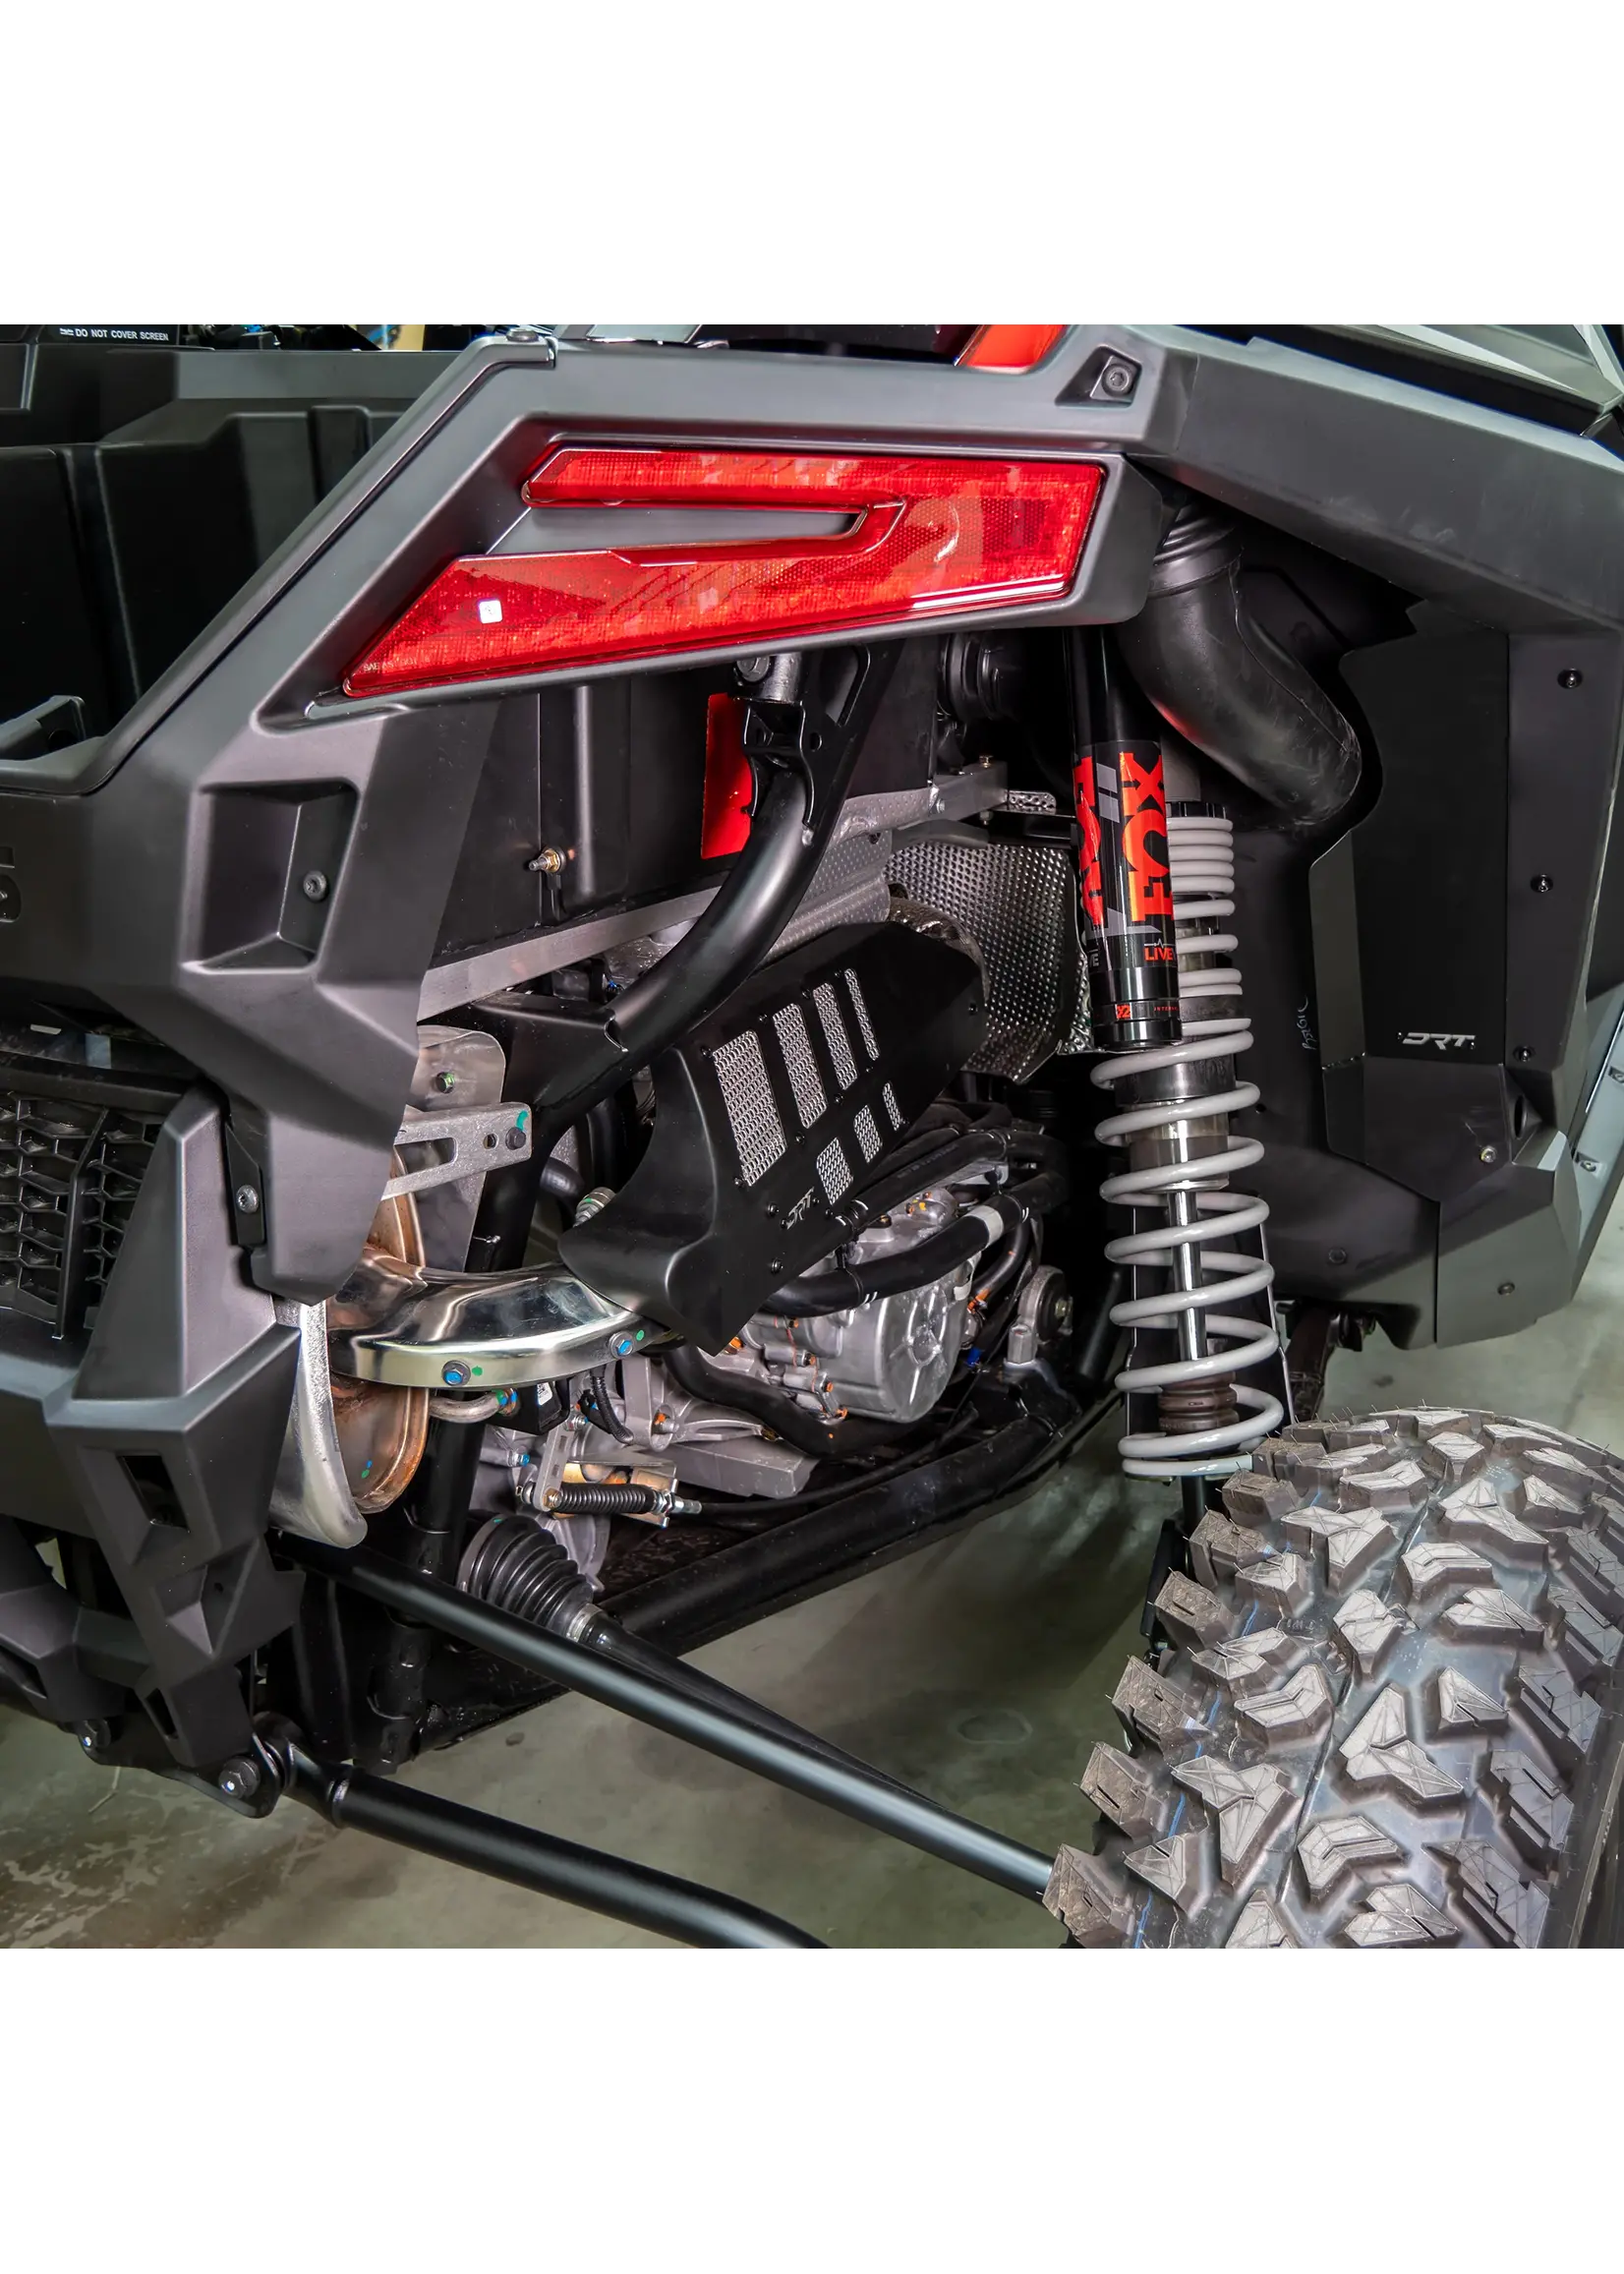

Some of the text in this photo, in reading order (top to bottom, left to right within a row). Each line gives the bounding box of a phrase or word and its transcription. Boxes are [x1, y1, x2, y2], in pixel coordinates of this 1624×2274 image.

[75, 327, 88, 337] DO
[90, 328, 108, 338] NOT
[110, 329, 138, 339] COVER
[140, 331, 169, 341] SCREEN
[1119, 751, 1174, 922] FOX
[1143, 947, 1174, 962] LIVE
[1402, 1031, 1476, 1051] DRT
